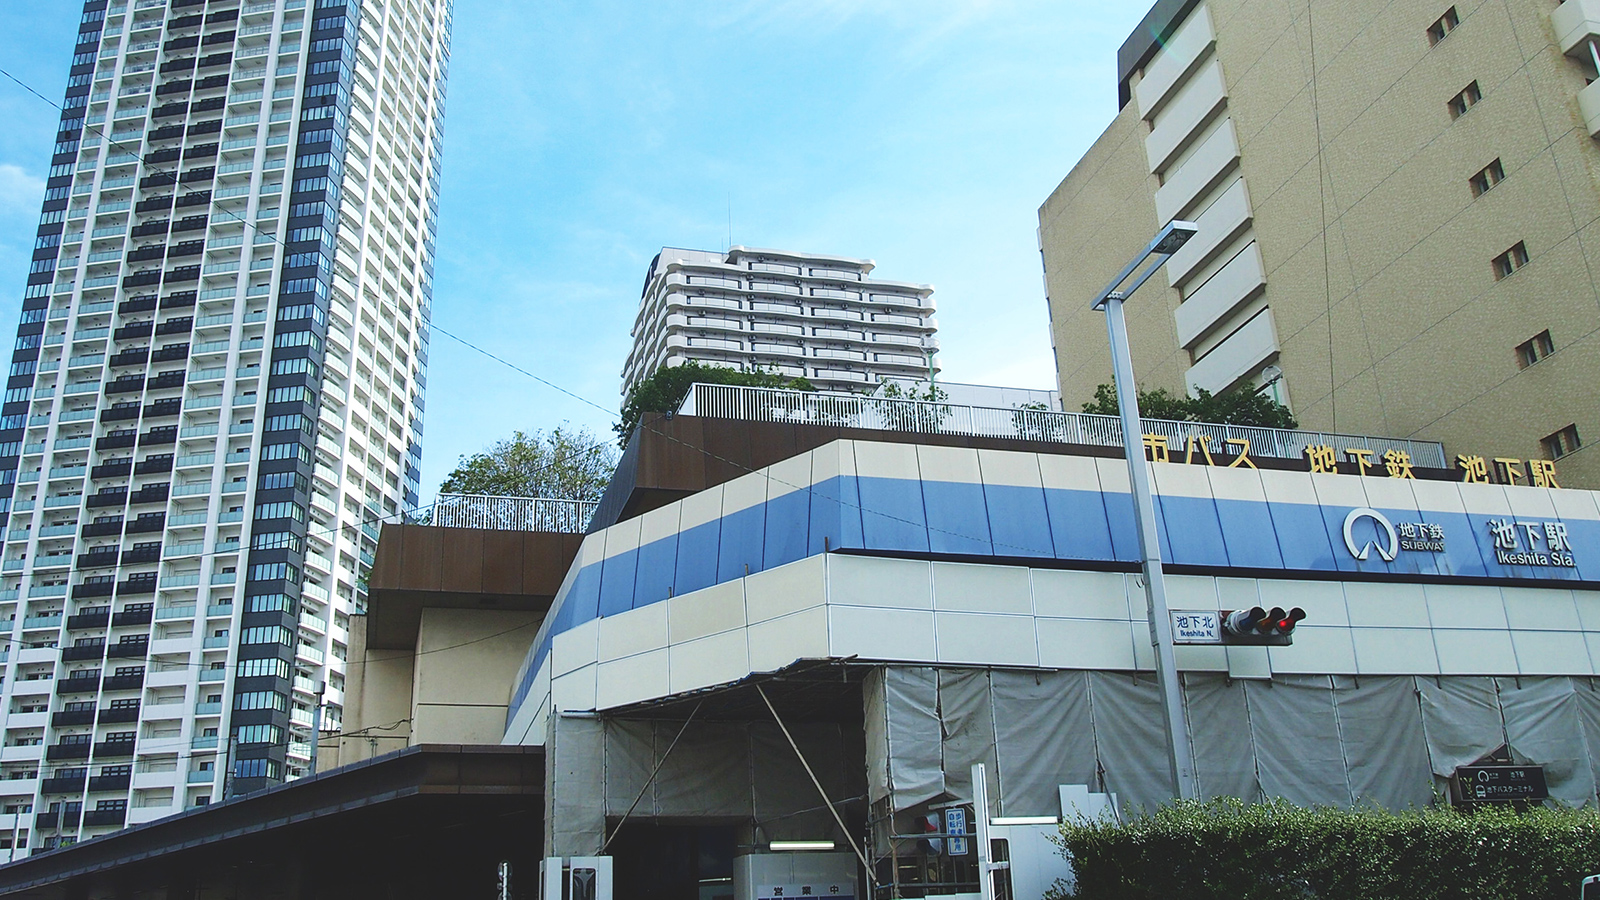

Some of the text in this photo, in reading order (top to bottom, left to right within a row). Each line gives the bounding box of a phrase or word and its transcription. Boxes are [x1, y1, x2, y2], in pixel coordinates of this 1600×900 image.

[1142, 432, 1561, 489] 市バス 地下鉄 池下駅
[1400, 522, 1445, 540] 地下鉄
[1490, 518, 1571, 551] 池下駅
[1401, 540, 1444, 551] SUBWAY
[1499, 551, 1576, 567] Ikeshita Sta.
[1176, 616, 1214, 628] 池下北
[773, 884, 840, 897] 営業中
